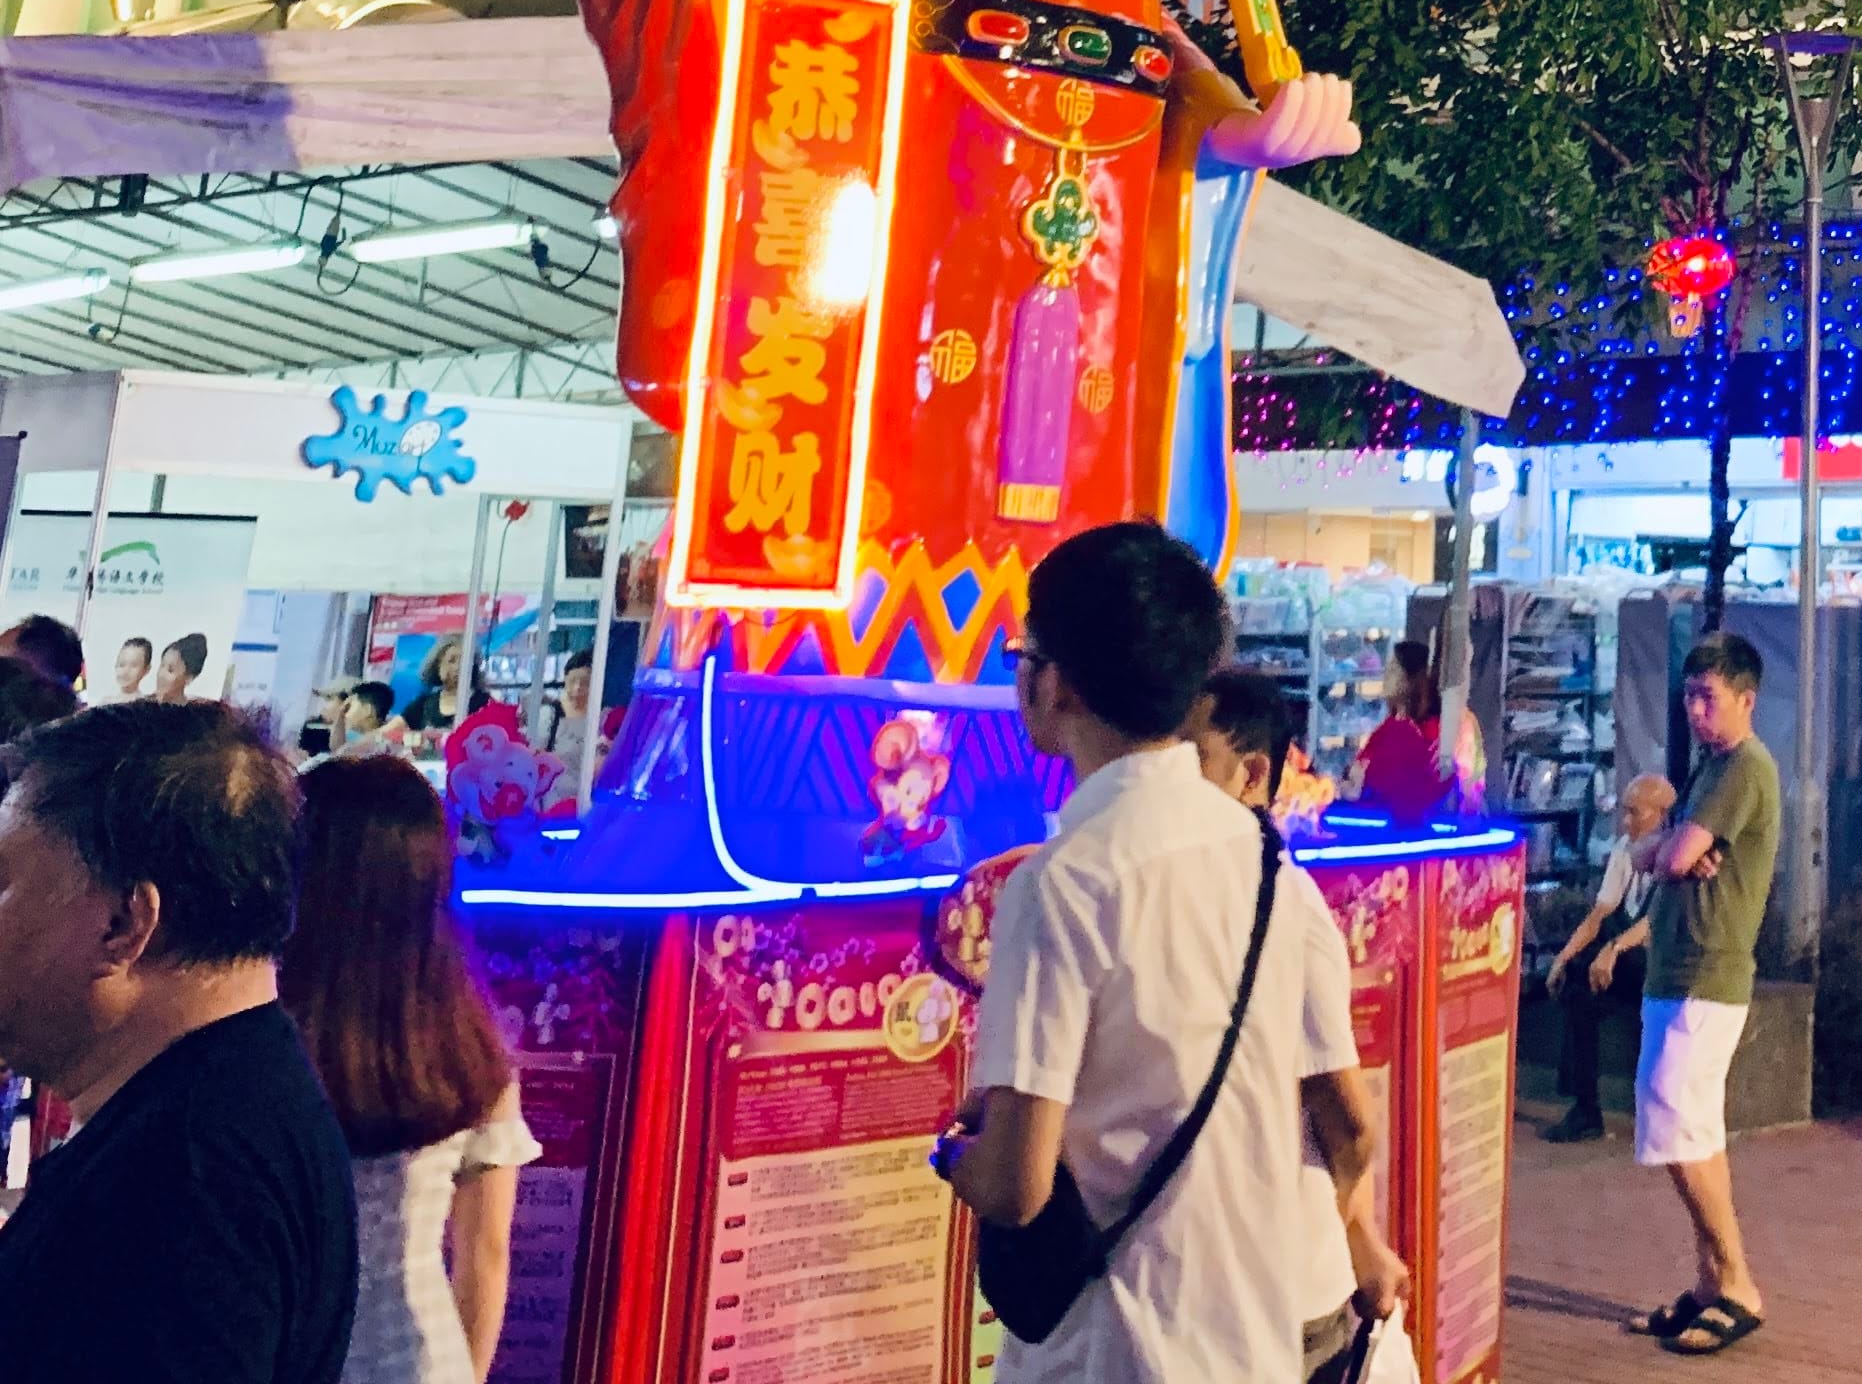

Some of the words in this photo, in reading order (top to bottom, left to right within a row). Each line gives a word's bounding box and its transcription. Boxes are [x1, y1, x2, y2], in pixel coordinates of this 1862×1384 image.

[725, 38, 859, 533] 恭喜发财
[928, 329, 977, 384] 福
